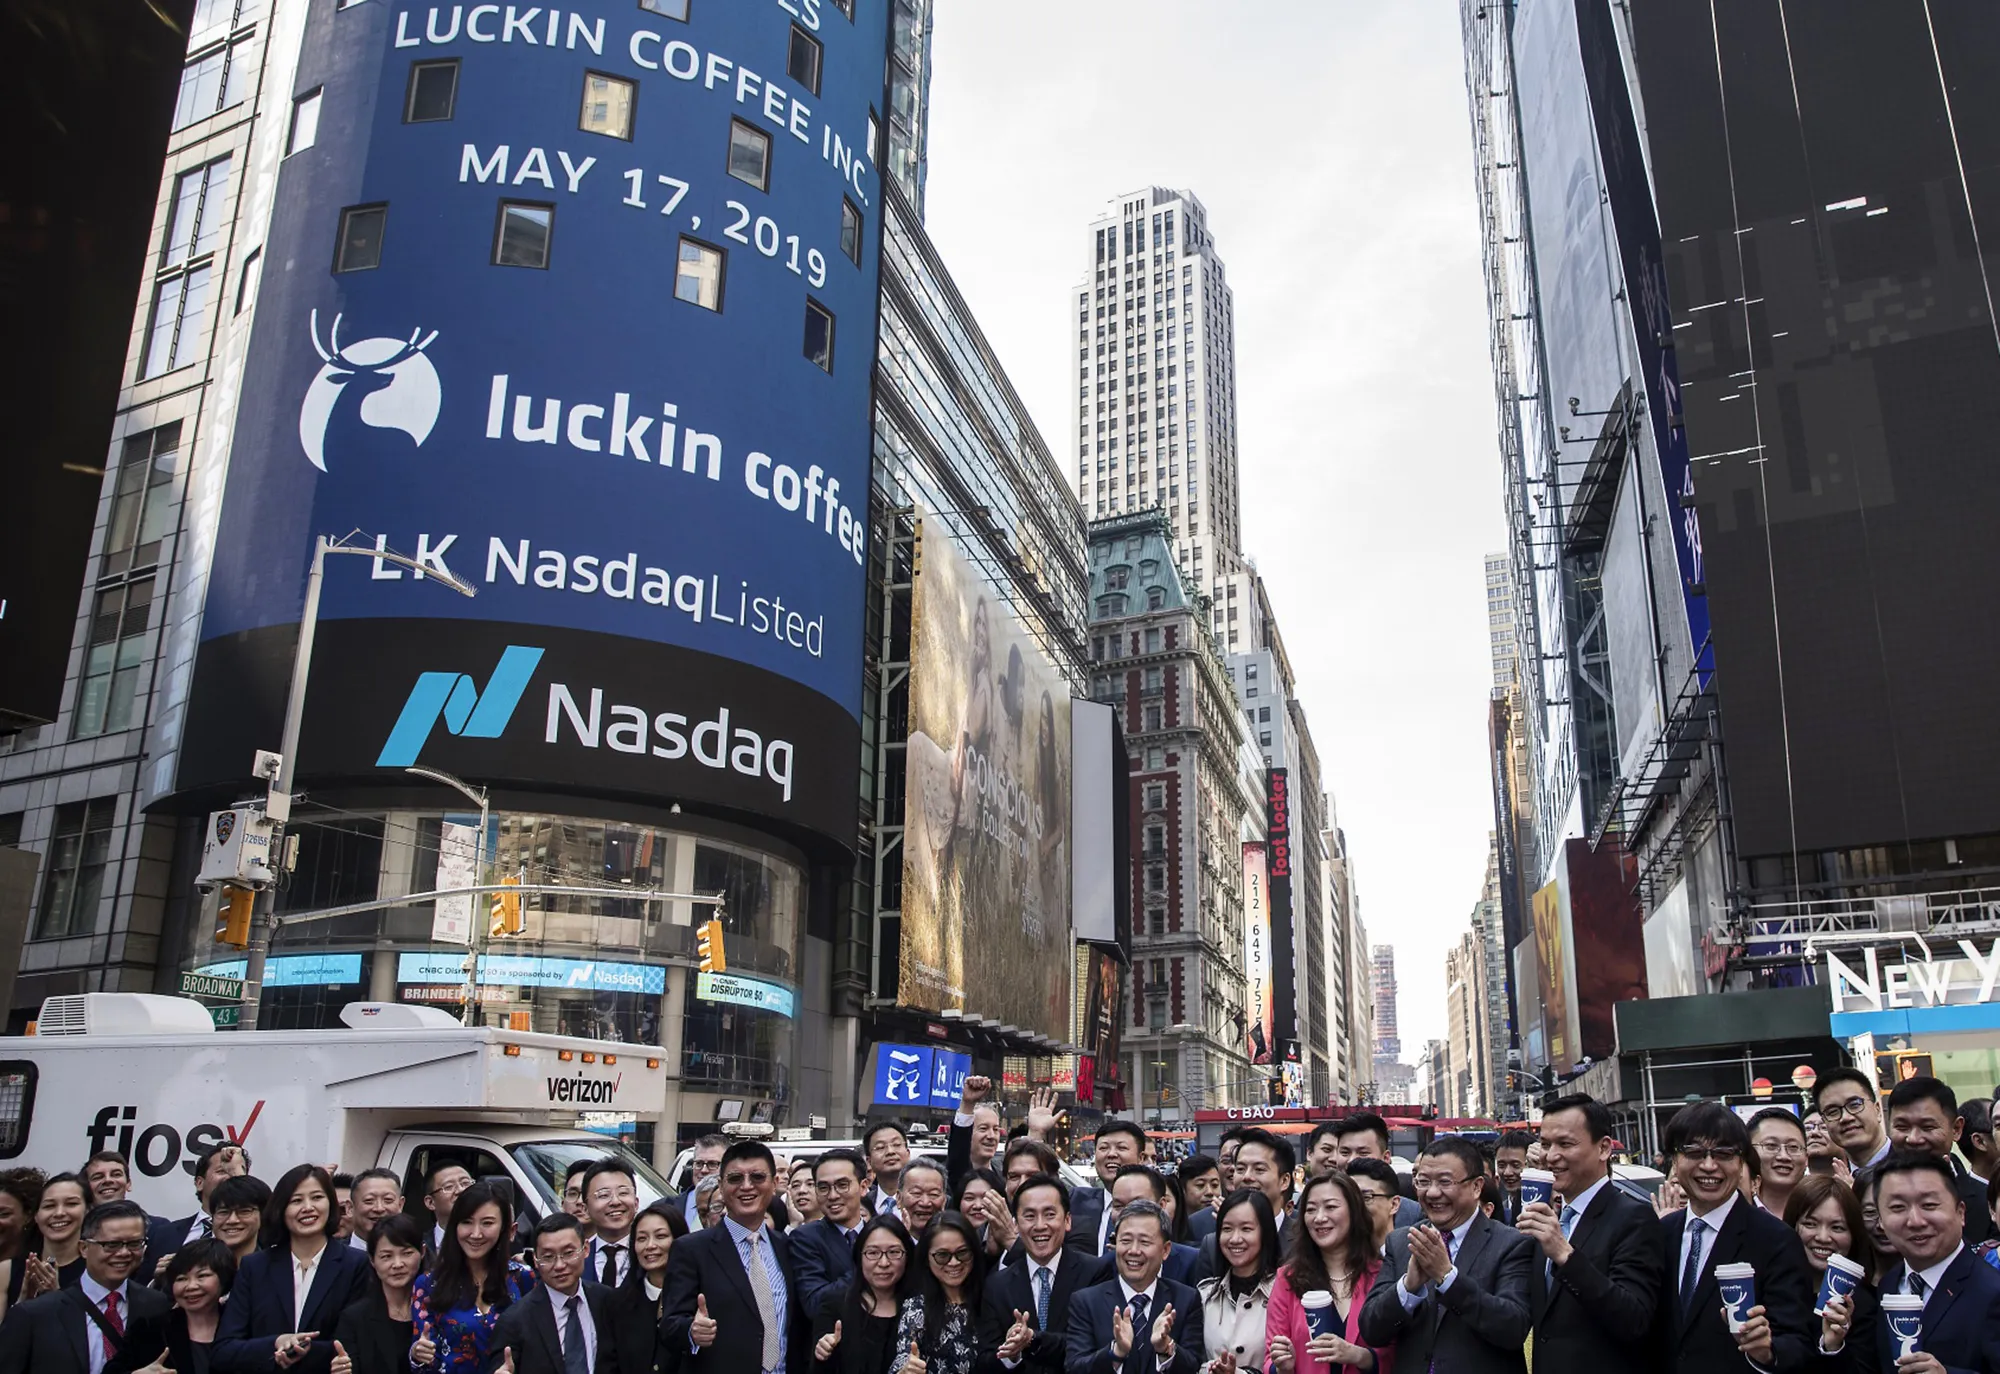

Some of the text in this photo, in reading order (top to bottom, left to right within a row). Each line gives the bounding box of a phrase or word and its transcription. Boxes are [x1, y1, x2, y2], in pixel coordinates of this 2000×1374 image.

[778, 0, 820, 31] S
[395, 4, 869, 207] LUCKIN COFFEE INC.
[459, 144, 828, 289] MAY 17, 2019
[486, 373, 864, 566] luckin coffee
[371, 532, 459, 581] LK
[545, 682, 794, 802] Nasdaq
[965, 745, 1045, 840] CONSCIOUS
[1269, 773, 1288, 877] Foot Locker
[182, 975, 241, 998] BROADWAY
[404, 988, 462, 999] BRANDED
[418, 966, 443, 975] CNBC
[486, 968, 498, 976] 50
[508, 970, 551, 979] sponsored
[552, 971, 564, 980] by
[595, 970, 644, 989] Nasdaq
[710, 983, 753, 999] DISRUPTOR
[754, 990, 764, 1001] 50
[1826, 946, 1954, 1013] NEW
[217, 1008, 231, 1024] 43
[547, 1070, 613, 1104] verizon
[1227, 1107, 1275, 1119] C BAO
[86, 1105, 225, 1177] fios
